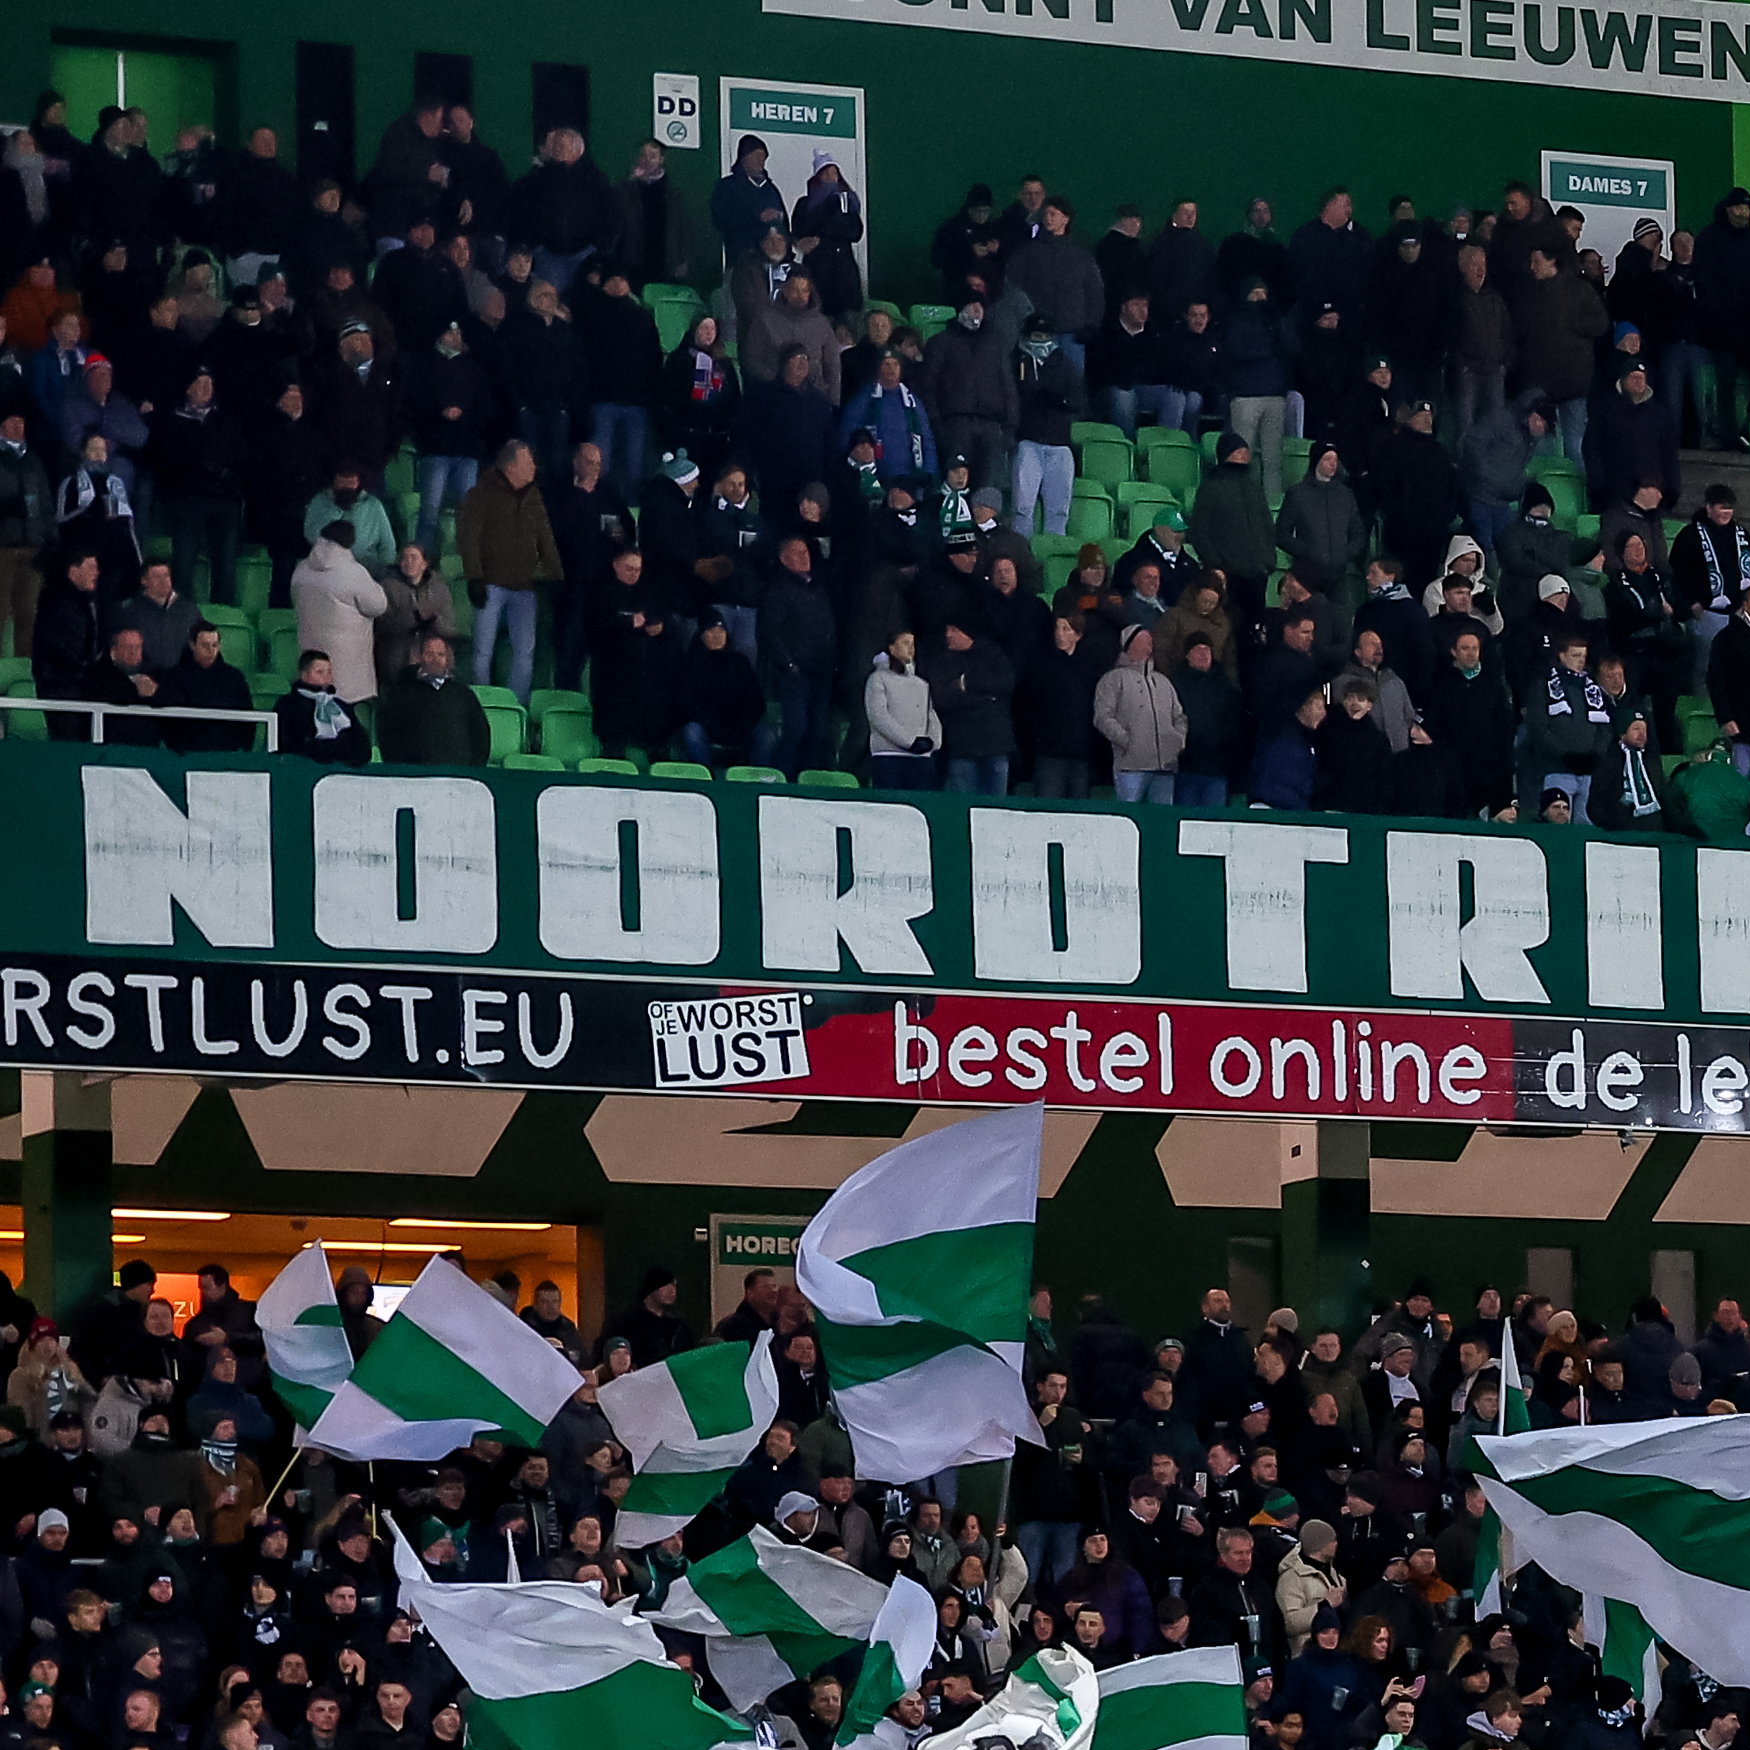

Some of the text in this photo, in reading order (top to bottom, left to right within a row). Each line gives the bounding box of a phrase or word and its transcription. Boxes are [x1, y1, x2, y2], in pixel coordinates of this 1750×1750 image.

[657, 96, 696, 116] DD
[751, 102, 834, 124] HEREN 7
[1568, 175, 1648, 197] DAMES 7
[0, 967, 574, 1070] RSTLUST.EU
[650, 997, 798, 1033] OF WORST
[655, 1019, 678, 1036] JE
[656, 1029, 801, 1083] LUST
[895, 1000, 1173, 1095] bestel
[1210, 1019, 1488, 1105] online
[1545, 1028, 1645, 1112] de
